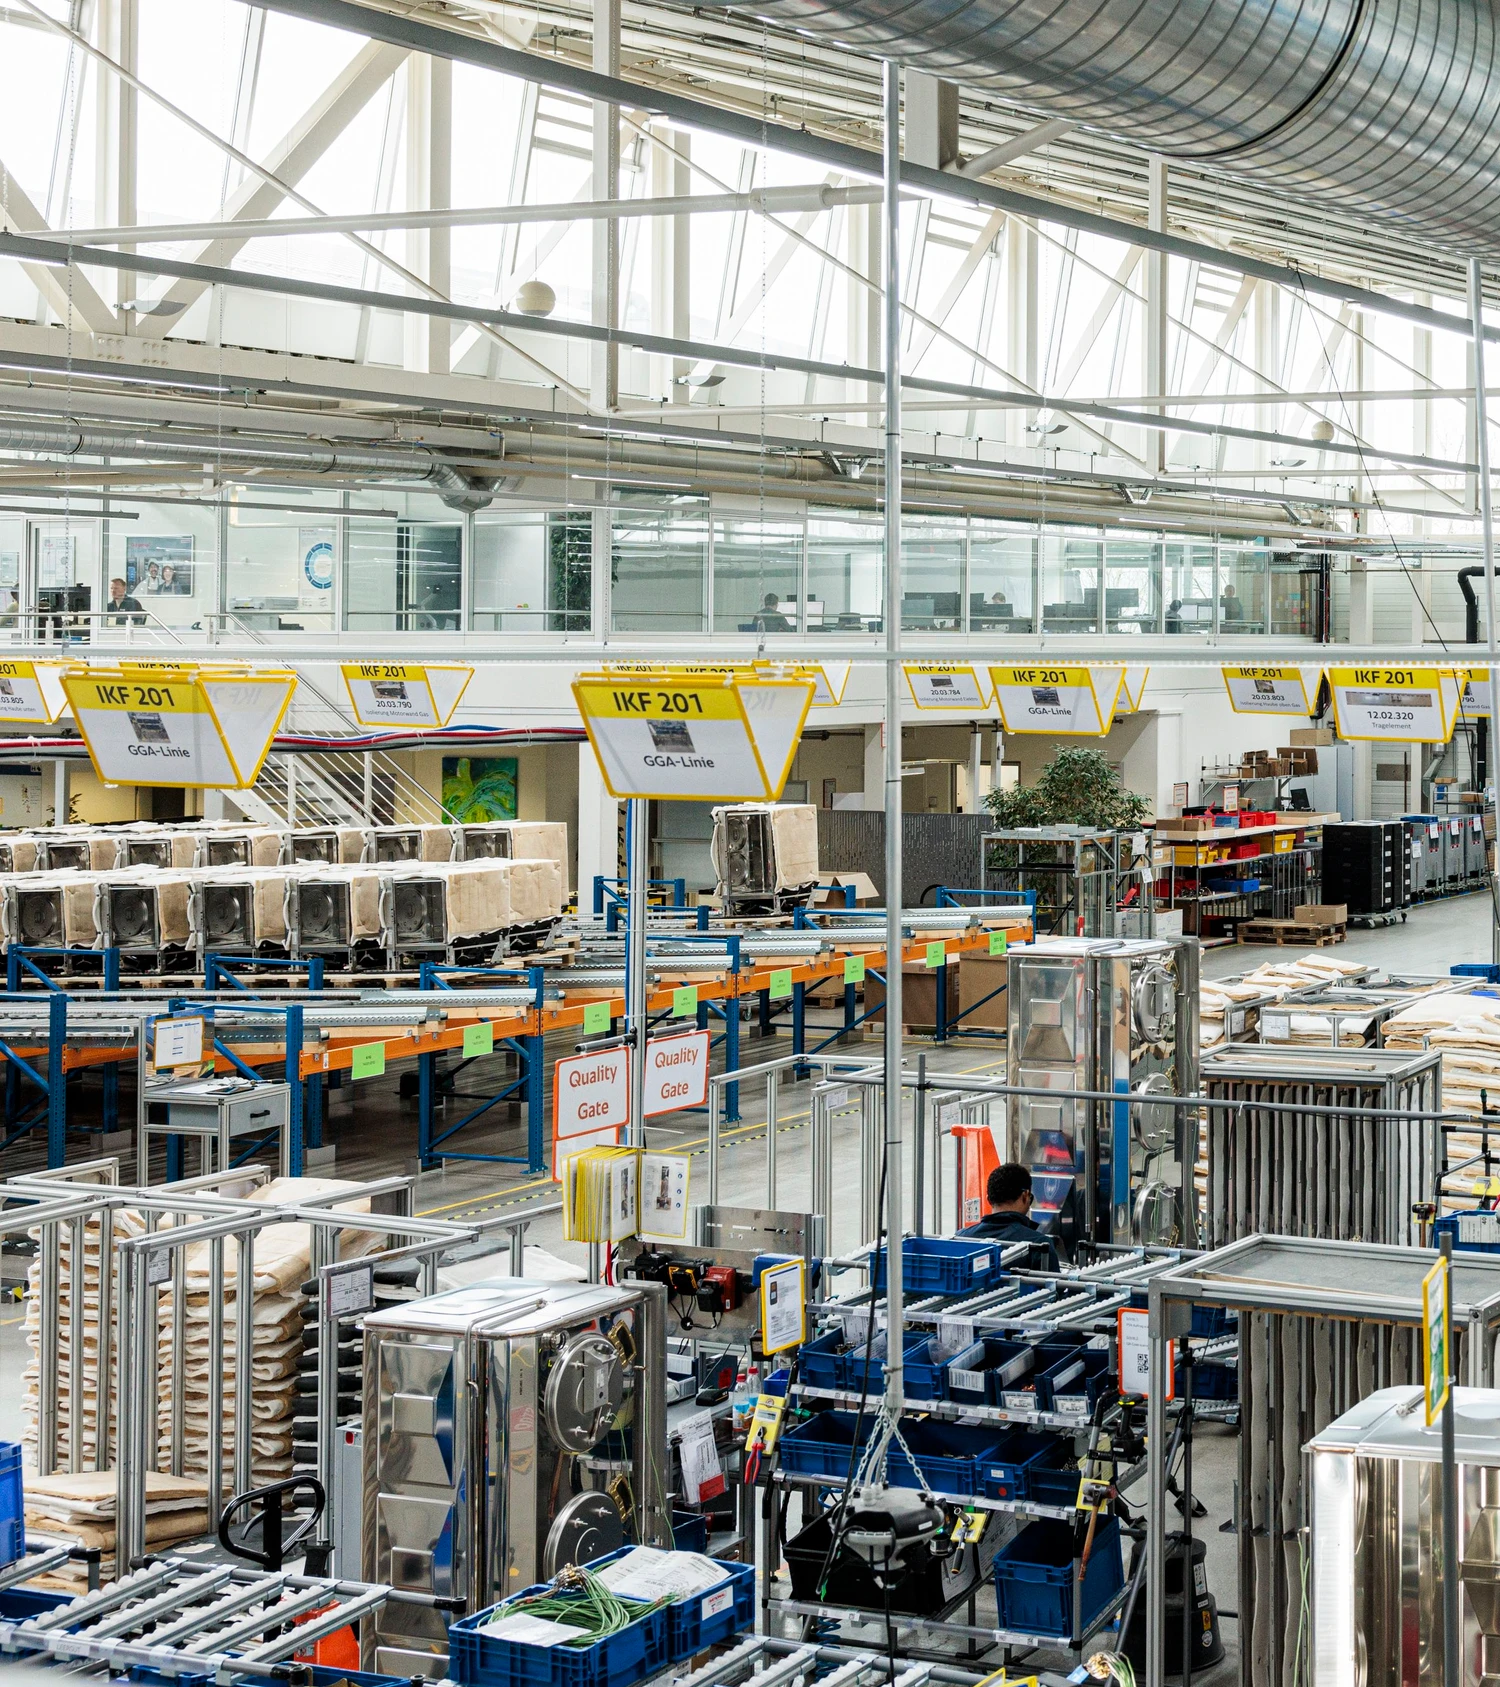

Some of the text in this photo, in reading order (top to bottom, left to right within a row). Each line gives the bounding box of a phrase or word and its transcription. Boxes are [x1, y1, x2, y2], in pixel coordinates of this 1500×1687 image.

[360, 666, 407, 677] IKF 201
[1013, 670, 1067, 683] IKF 201
[1240, 668, 1282, 678] IKF 201
[1355, 671, 1414, 684] IKF 201
[96, 685, 175, 706] IKF 201
[376, 700, 412, 708] 20.03.790
[613, 692, 703, 713] IKF 201
[1028, 707, 1072, 715] GGA-Linie
[1367, 711, 1414, 720] 12.02.320
[128, 744, 190, 758] GGA-Linie
[644, 755, 714, 768] GGA-Linie
[655, 1048, 699, 1068] Quality
[570, 1064, 618, 1088] Quality
[661, 1081, 689, 1099] Gate
[578, 1101, 609, 1120] Gate
